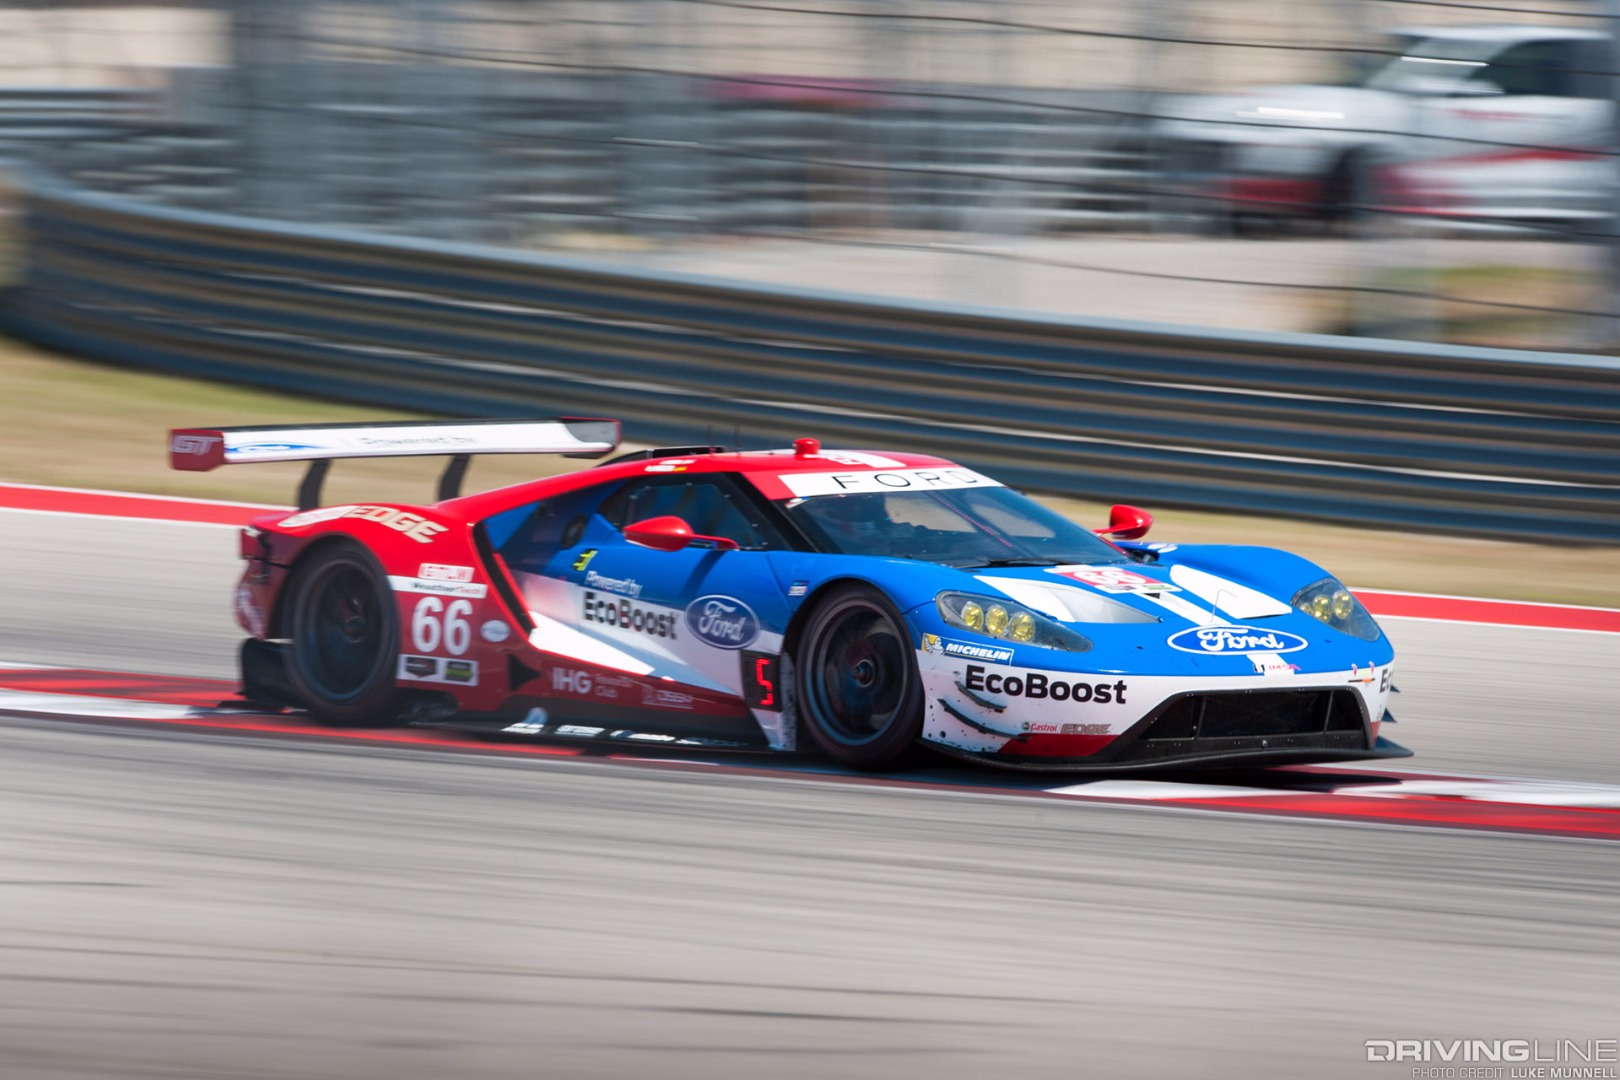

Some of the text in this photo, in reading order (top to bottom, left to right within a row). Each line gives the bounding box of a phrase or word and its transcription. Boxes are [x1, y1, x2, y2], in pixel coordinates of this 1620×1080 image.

[831, 470, 977, 489] FORD
[341, 505, 450, 544] EDGE
[584, 570, 643, 598] Powered by
[412, 596, 473, 656] 66
[584, 591, 677, 640] EcoBoost
[698, 600, 747, 641] Ford
[945, 642, 1011, 661] MICHELIN
[1196, 628, 1285, 651] Ford
[552, 666, 593, 694] IHG
[755, 657, 775, 706] 5
[966, 664, 1127, 704] EcoBoost
[1030, 722, 1112, 735] Castrol EDGE
